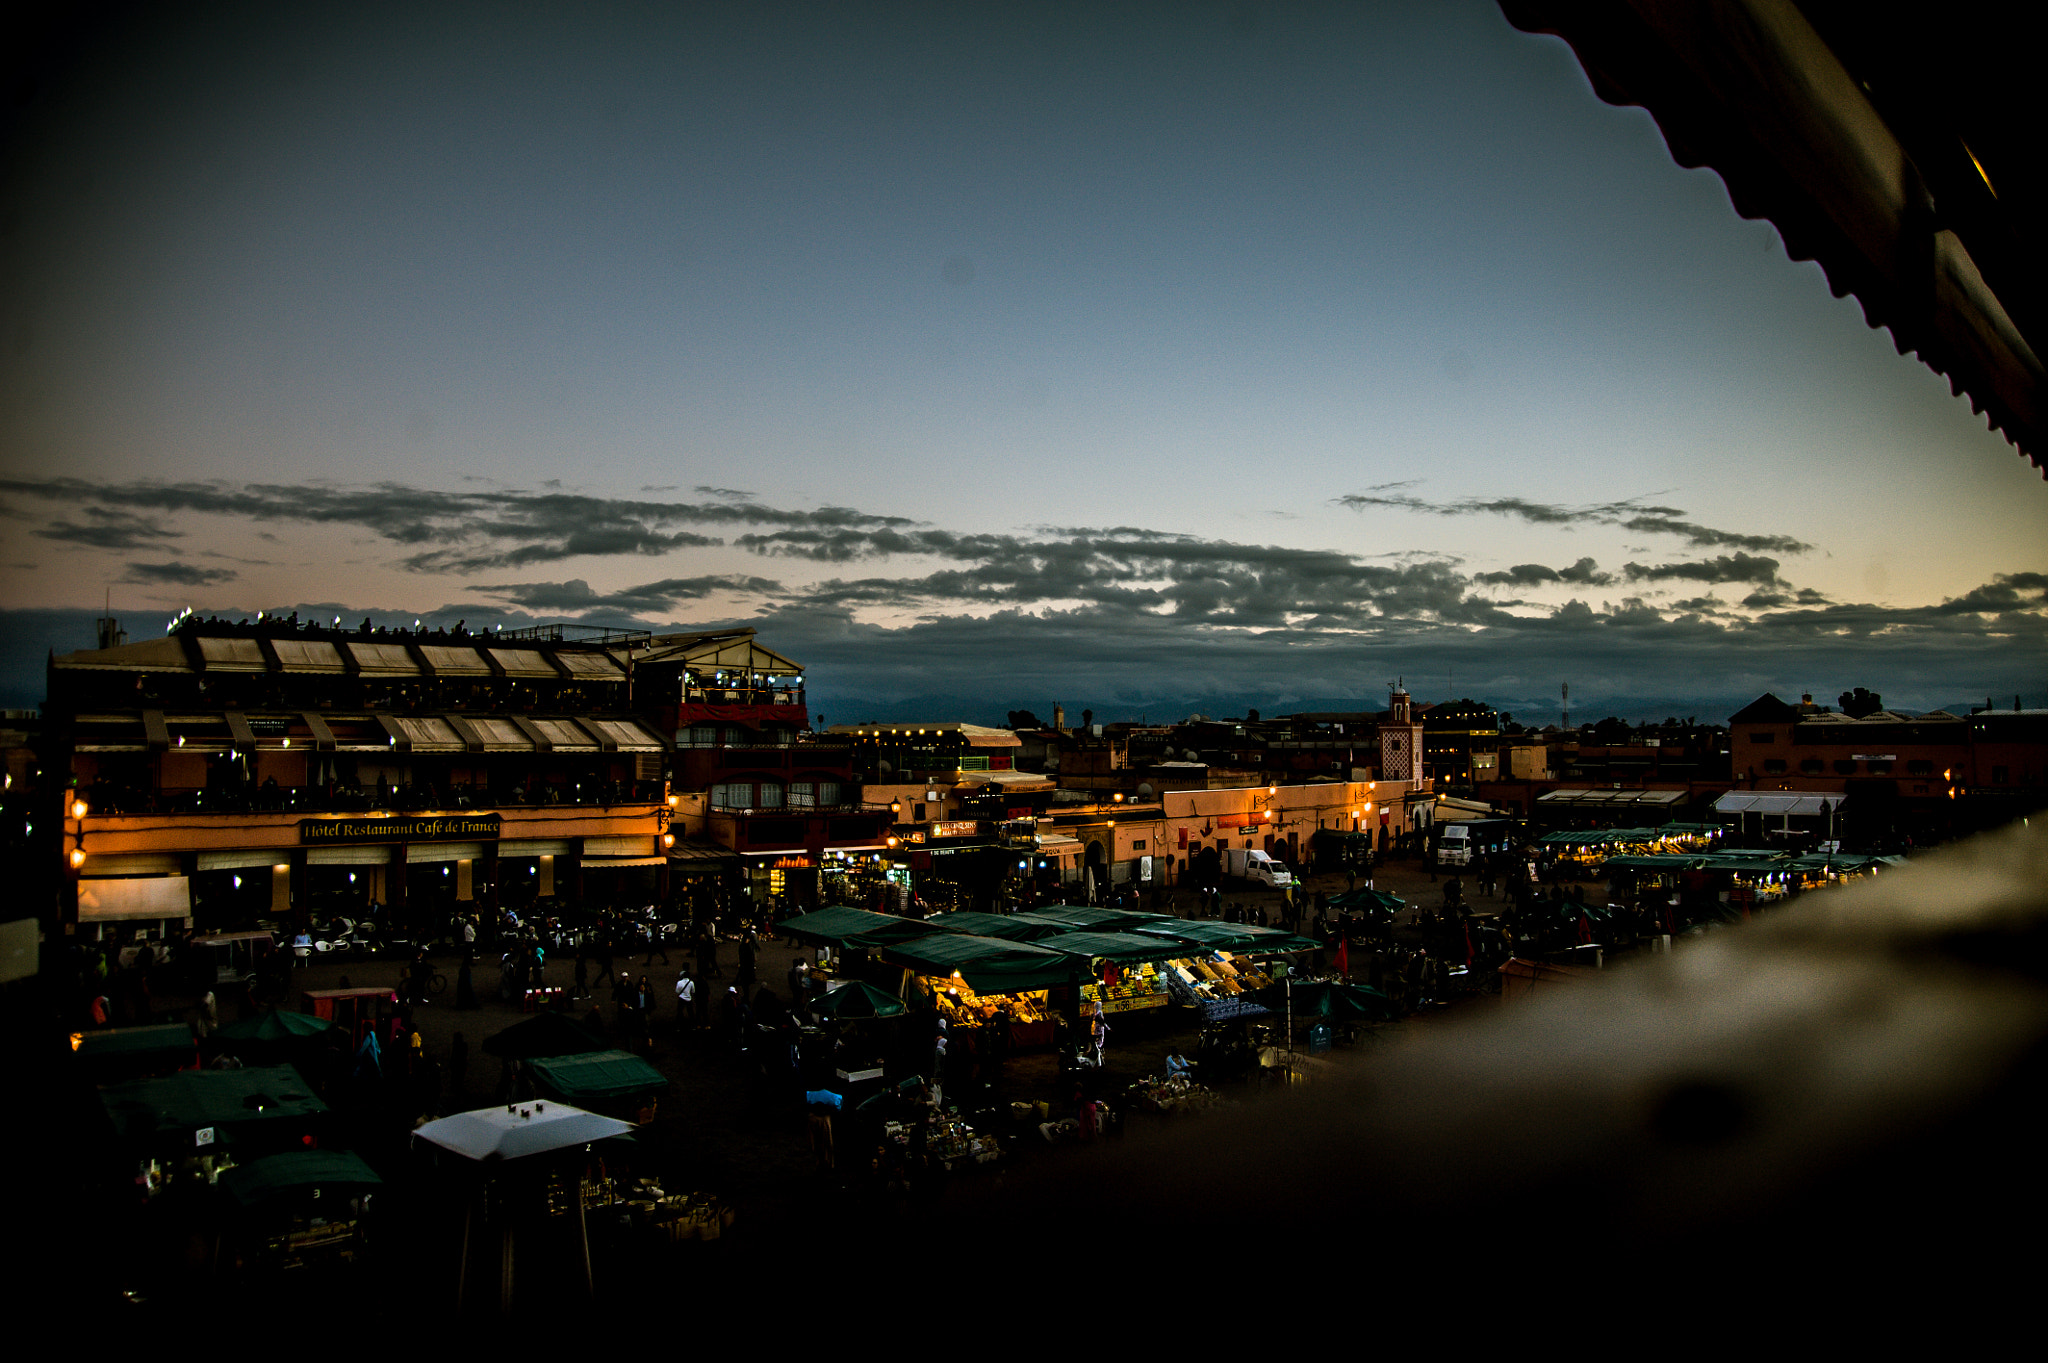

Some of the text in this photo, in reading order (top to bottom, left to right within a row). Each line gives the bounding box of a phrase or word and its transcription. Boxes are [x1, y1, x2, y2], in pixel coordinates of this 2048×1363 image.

[305, 819, 499, 838] Hôtel Restaurant Café de France
[313, 1188, 320, 1199] 3
